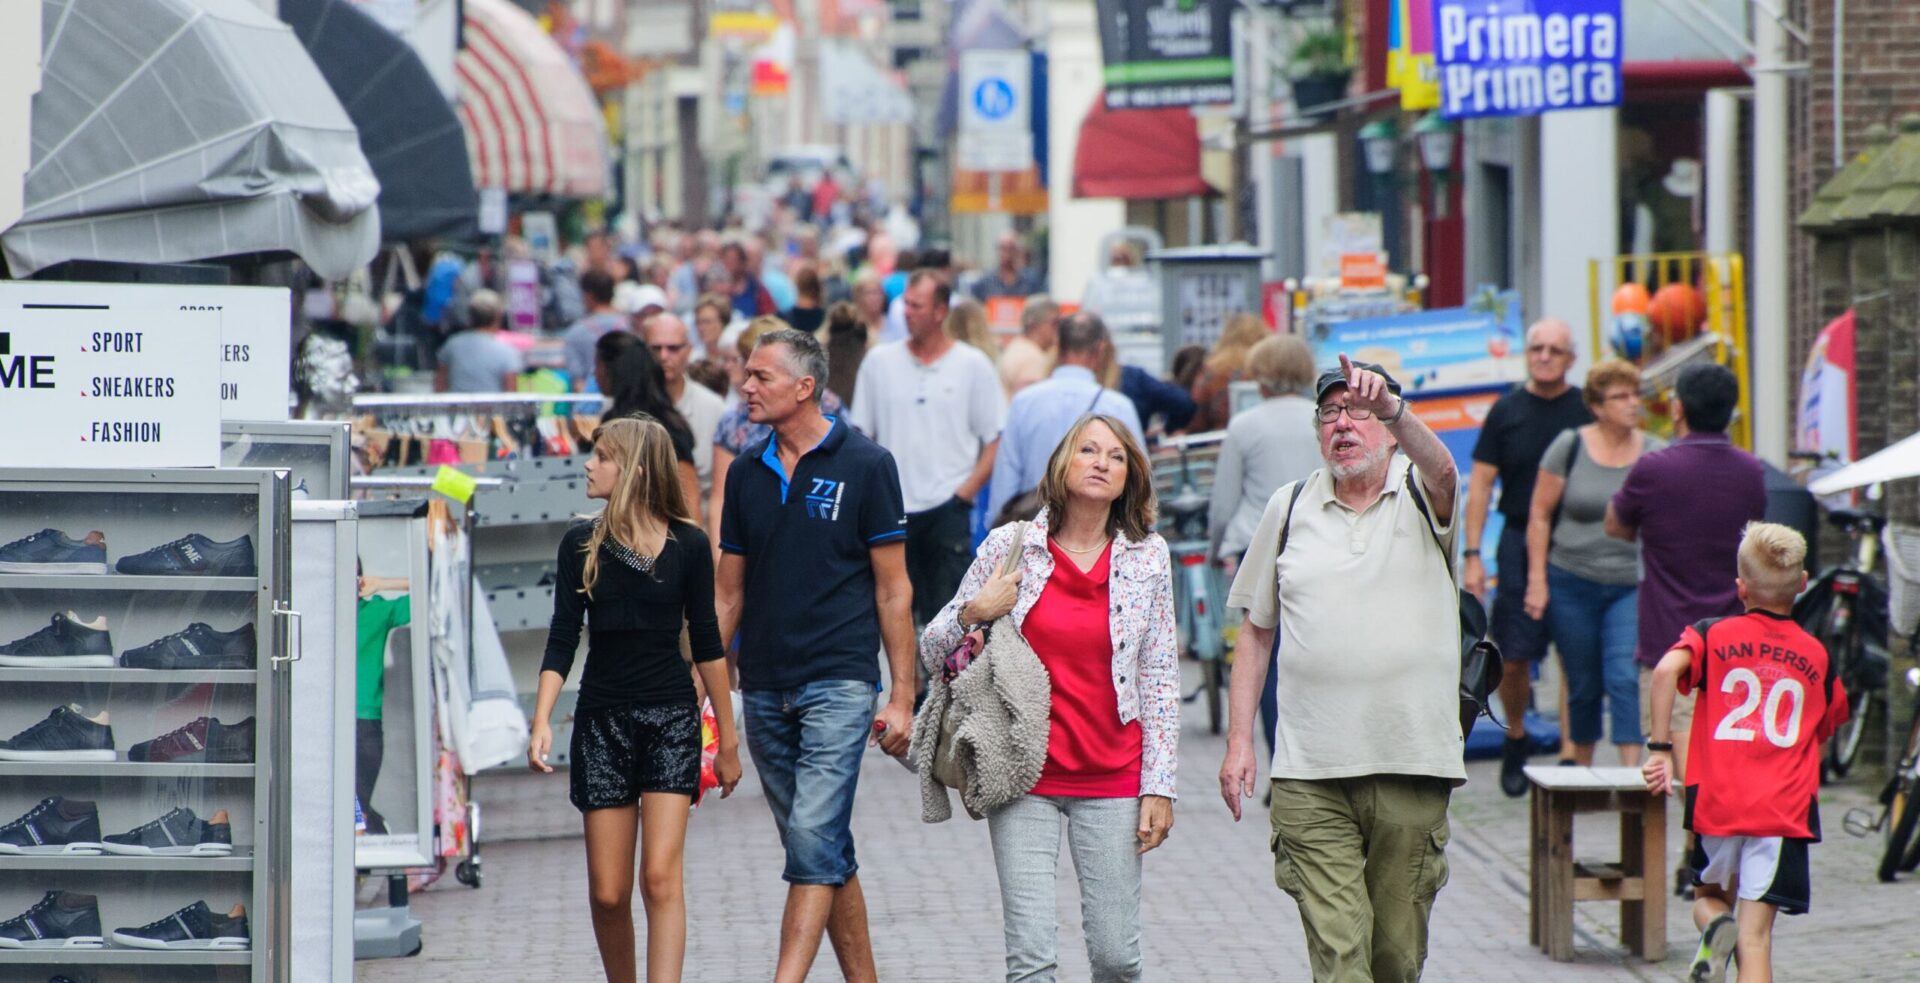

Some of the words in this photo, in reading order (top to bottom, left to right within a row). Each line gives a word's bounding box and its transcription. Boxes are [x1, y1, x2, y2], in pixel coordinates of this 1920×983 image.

[1440, 5, 1616, 61] Primera
[1447, 62, 1616, 113] Primera
[92, 332, 143, 352] SPORT
[92, 377, 175, 397] SNEAKERS
[92, 422, 161, 442] FASHION
[811, 478, 836, 496] 77
[181, 544, 203, 564] PME
[1714, 642, 1753, 662] VAN
[1760, 643, 1820, 686] PERSIE
[1713, 667, 1804, 748] 20
